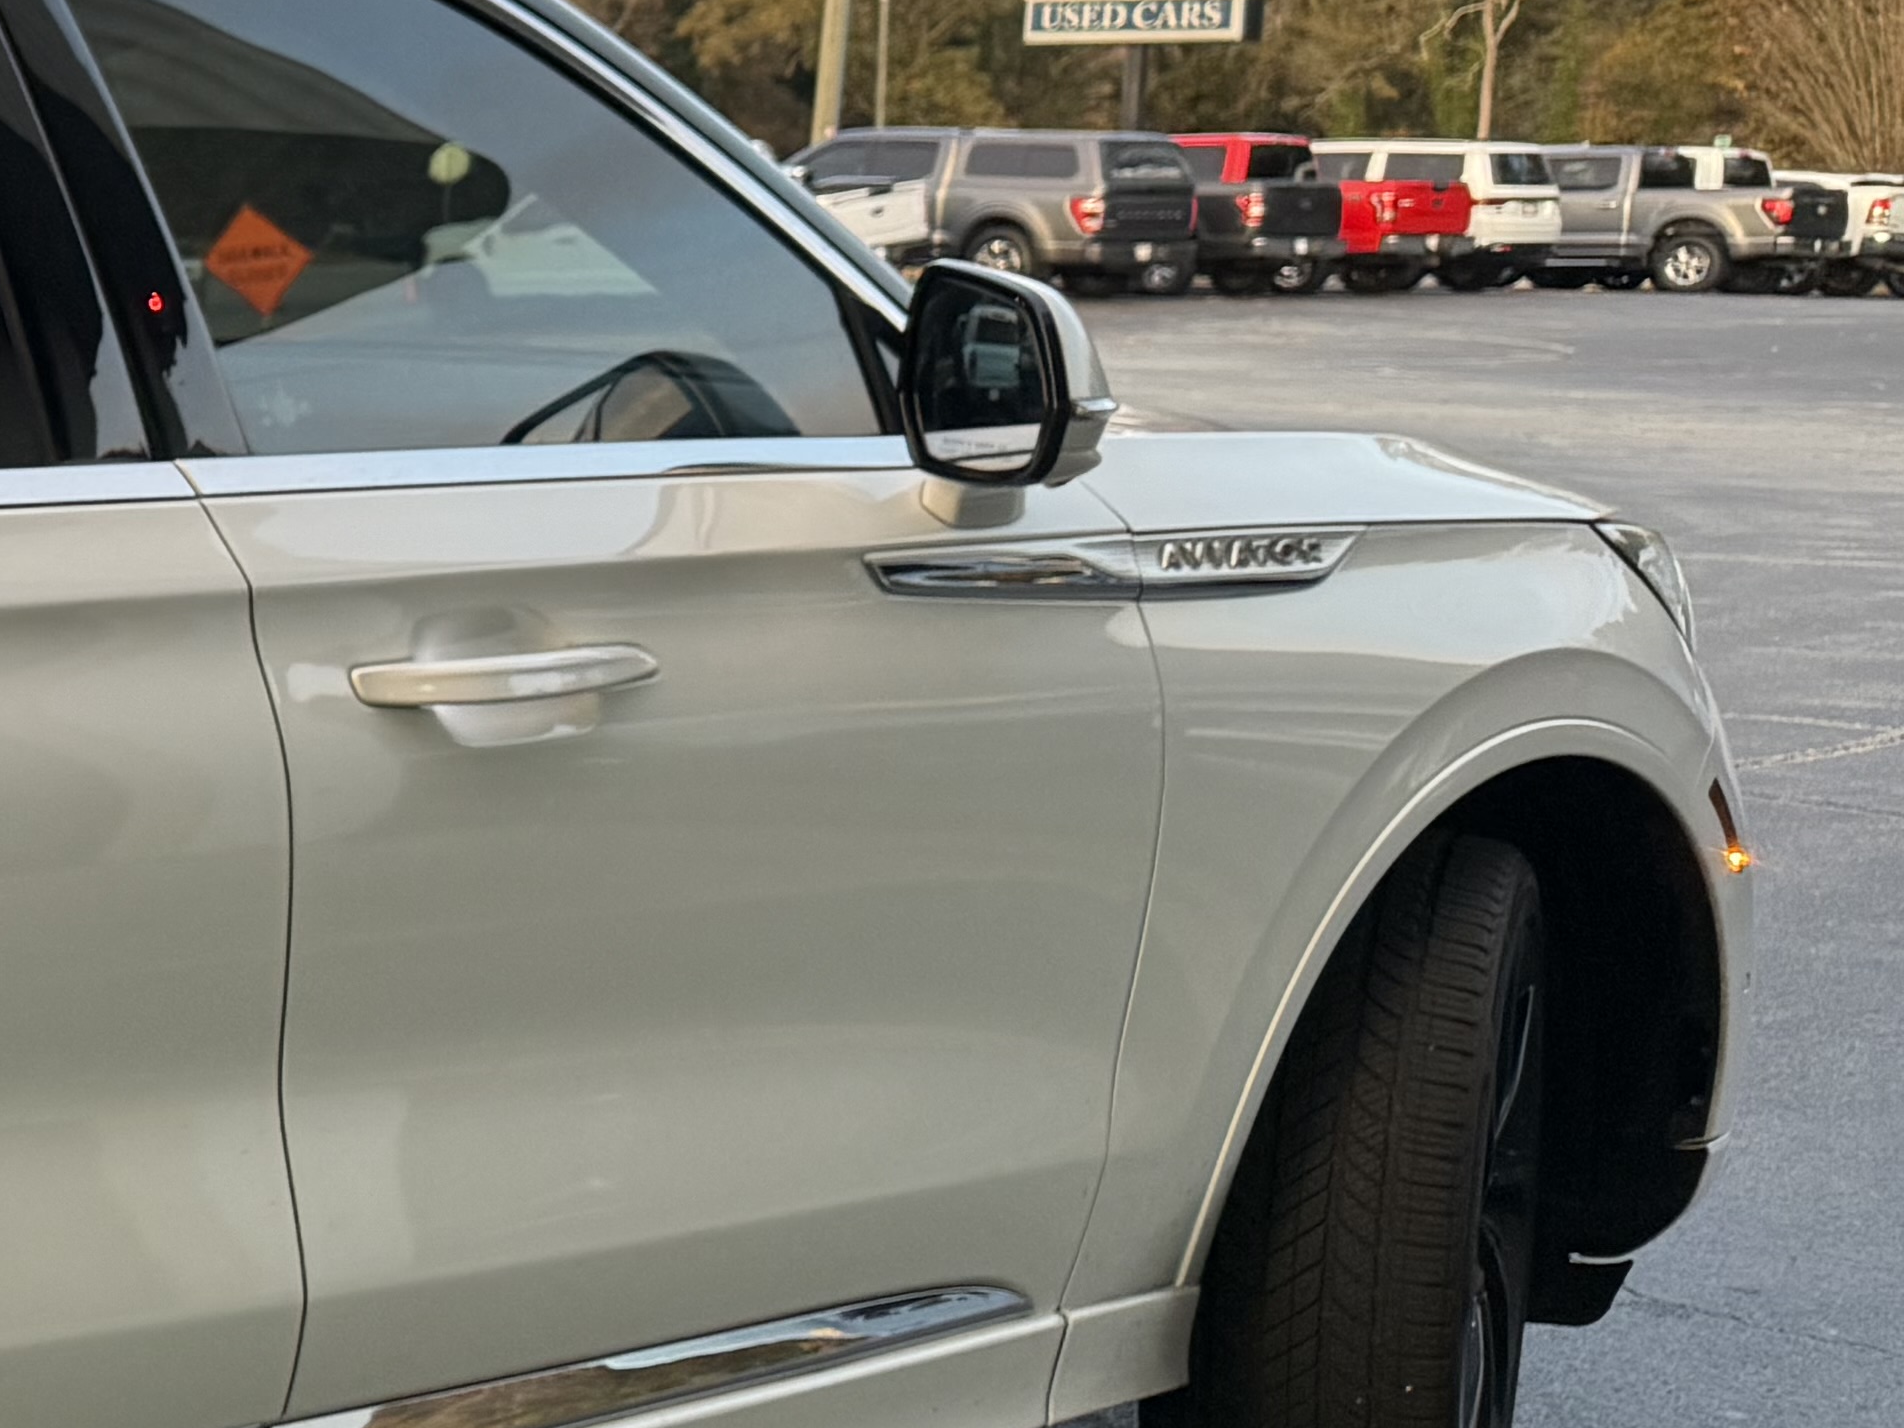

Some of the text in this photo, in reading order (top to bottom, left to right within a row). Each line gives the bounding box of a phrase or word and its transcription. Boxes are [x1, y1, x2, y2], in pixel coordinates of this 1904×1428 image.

[1041, 0, 1223, 31] USED CARS
[1158, 538, 1323, 570] AVIATOR
